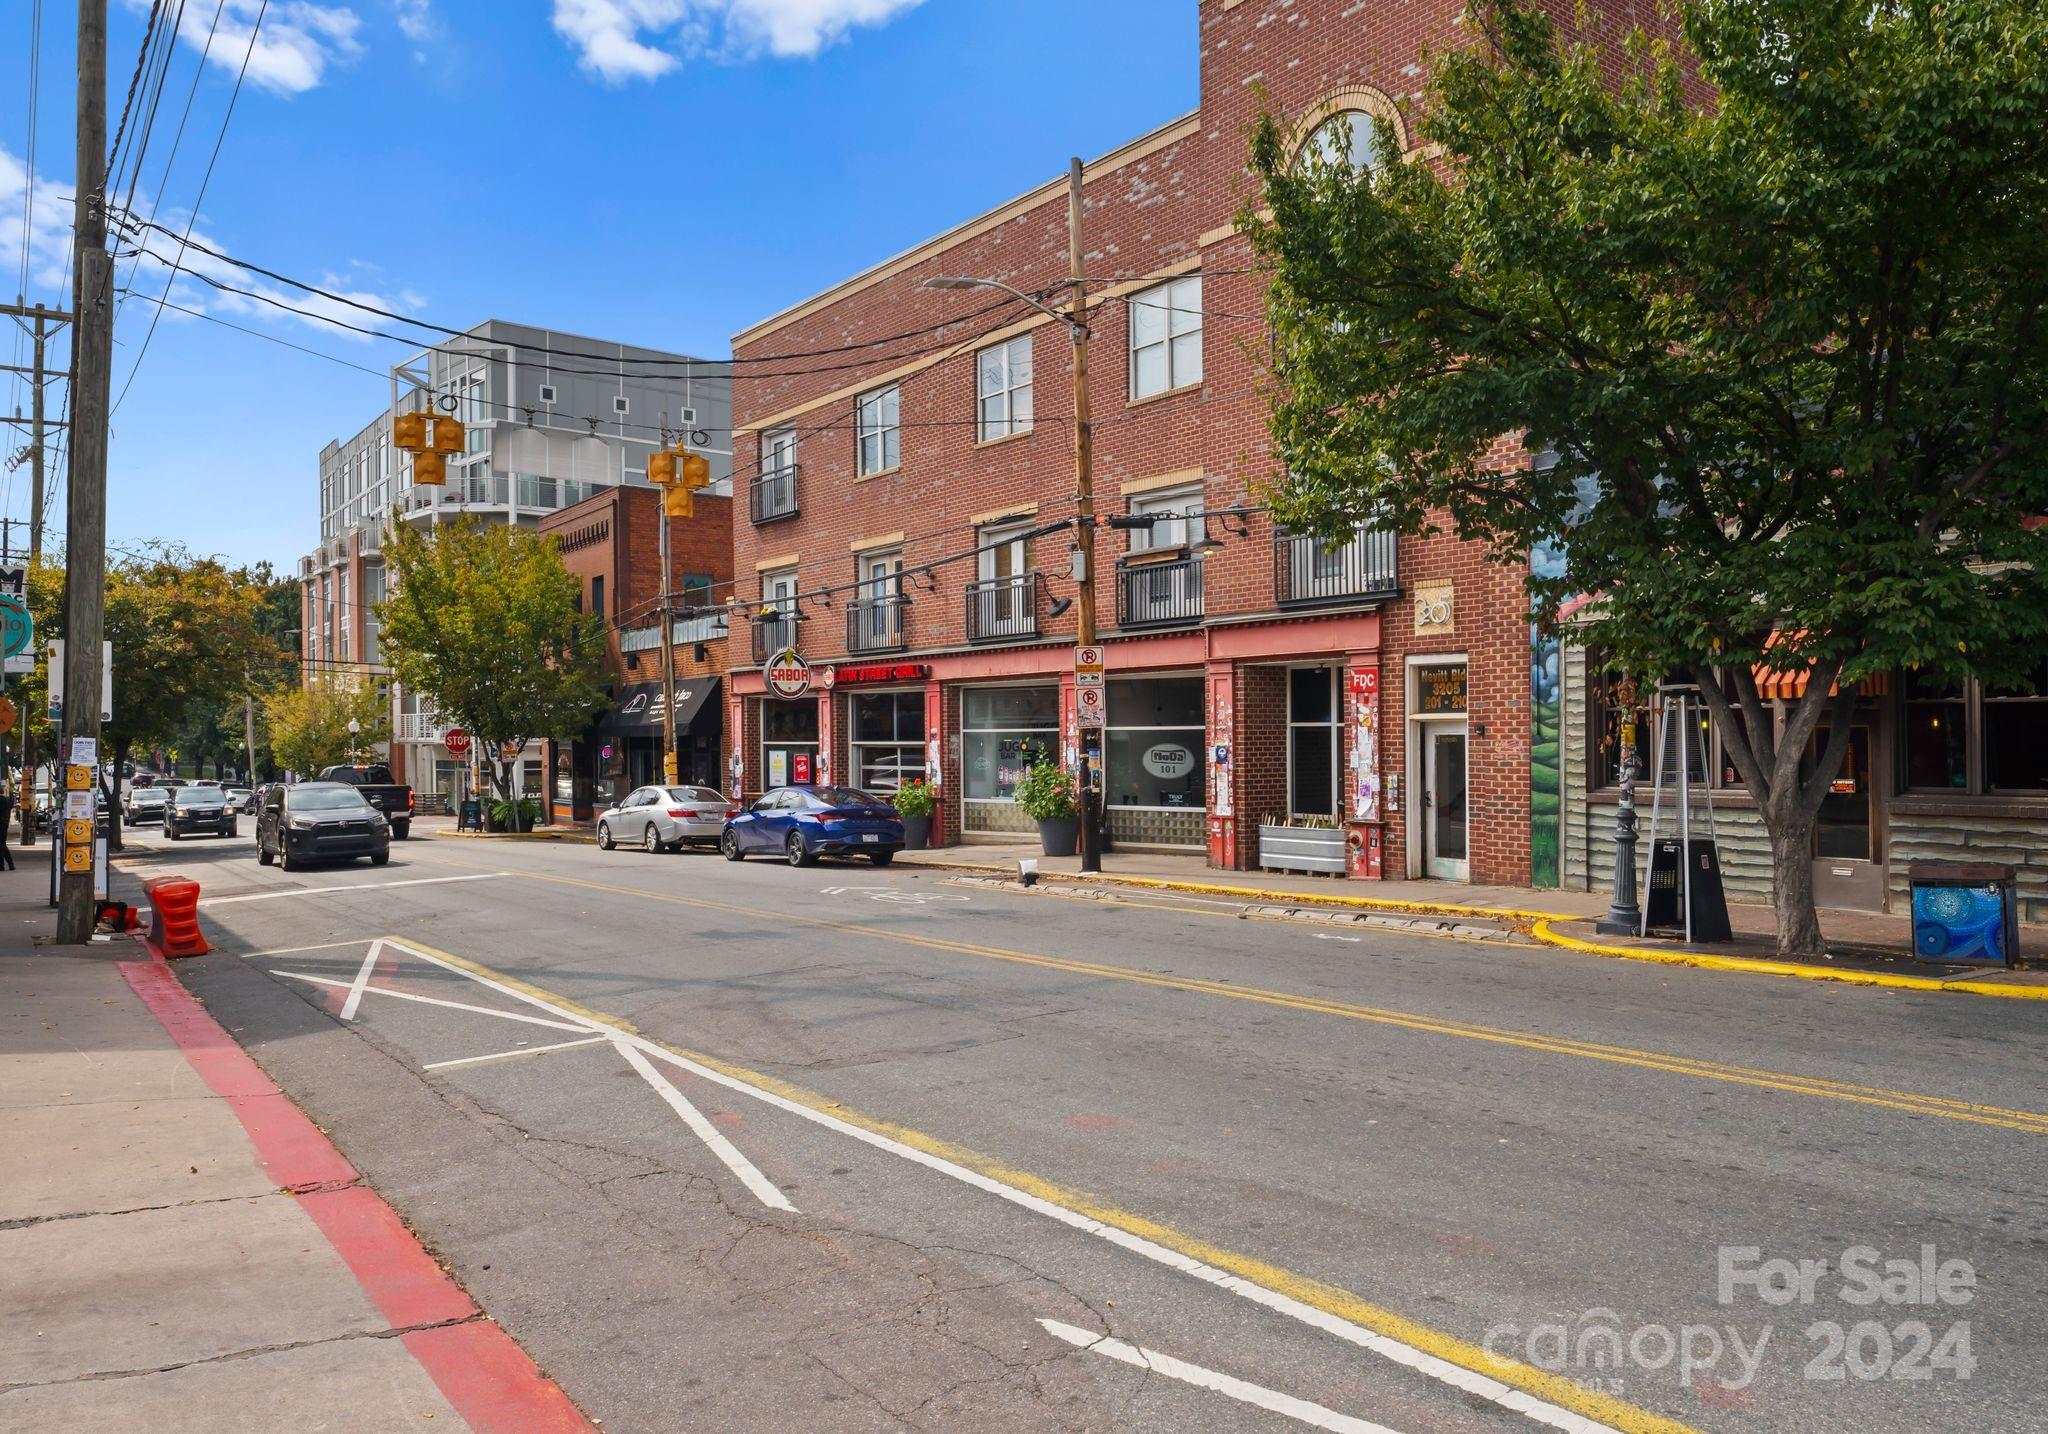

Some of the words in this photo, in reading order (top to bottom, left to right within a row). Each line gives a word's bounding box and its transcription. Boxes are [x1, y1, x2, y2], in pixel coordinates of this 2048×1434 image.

[1353, 674, 1375, 686] FDC
[1421, 669, 1448, 682] Nevitt
[1451, 668, 1466, 681] Bld
[1432, 682, 1460, 695] 3205
[1424, 696, 1441, 709] 201
[446, 735, 469, 746] STOP
[1000, 752, 1016, 760] BAR
[1153, 751, 1184, 762] NoDa
[1160, 765, 1176, 774] 101
